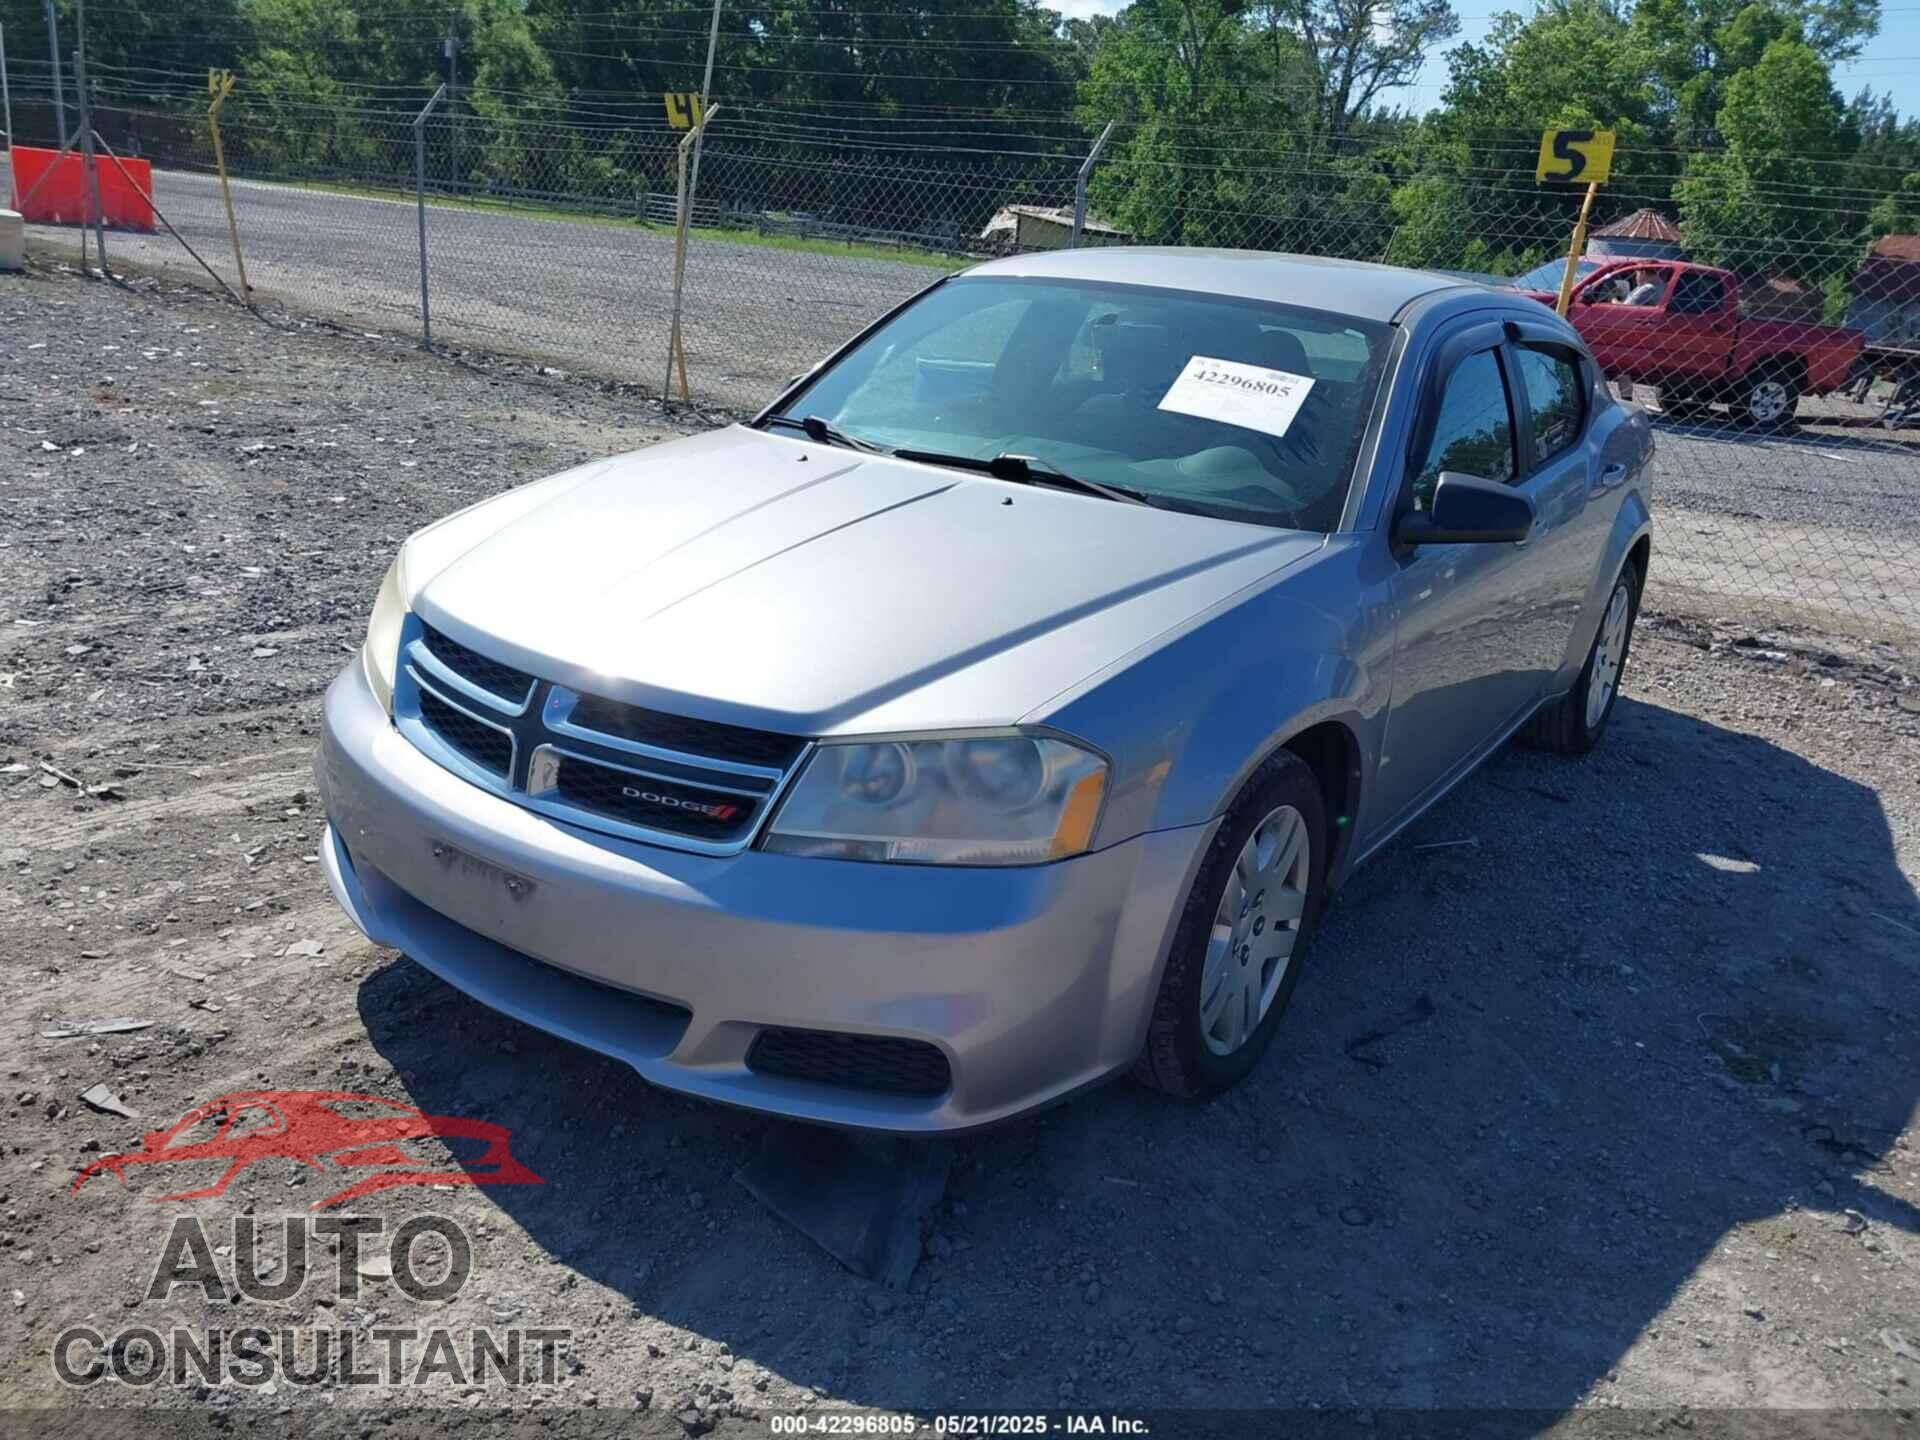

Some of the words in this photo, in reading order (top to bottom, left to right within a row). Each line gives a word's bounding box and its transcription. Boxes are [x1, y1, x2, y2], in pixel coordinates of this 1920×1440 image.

[672, 92, 696, 128] 4
[1543, 130, 1596, 182] 5
[1193, 369, 1293, 398] 42296805
[621, 786, 720, 817] DODGE
